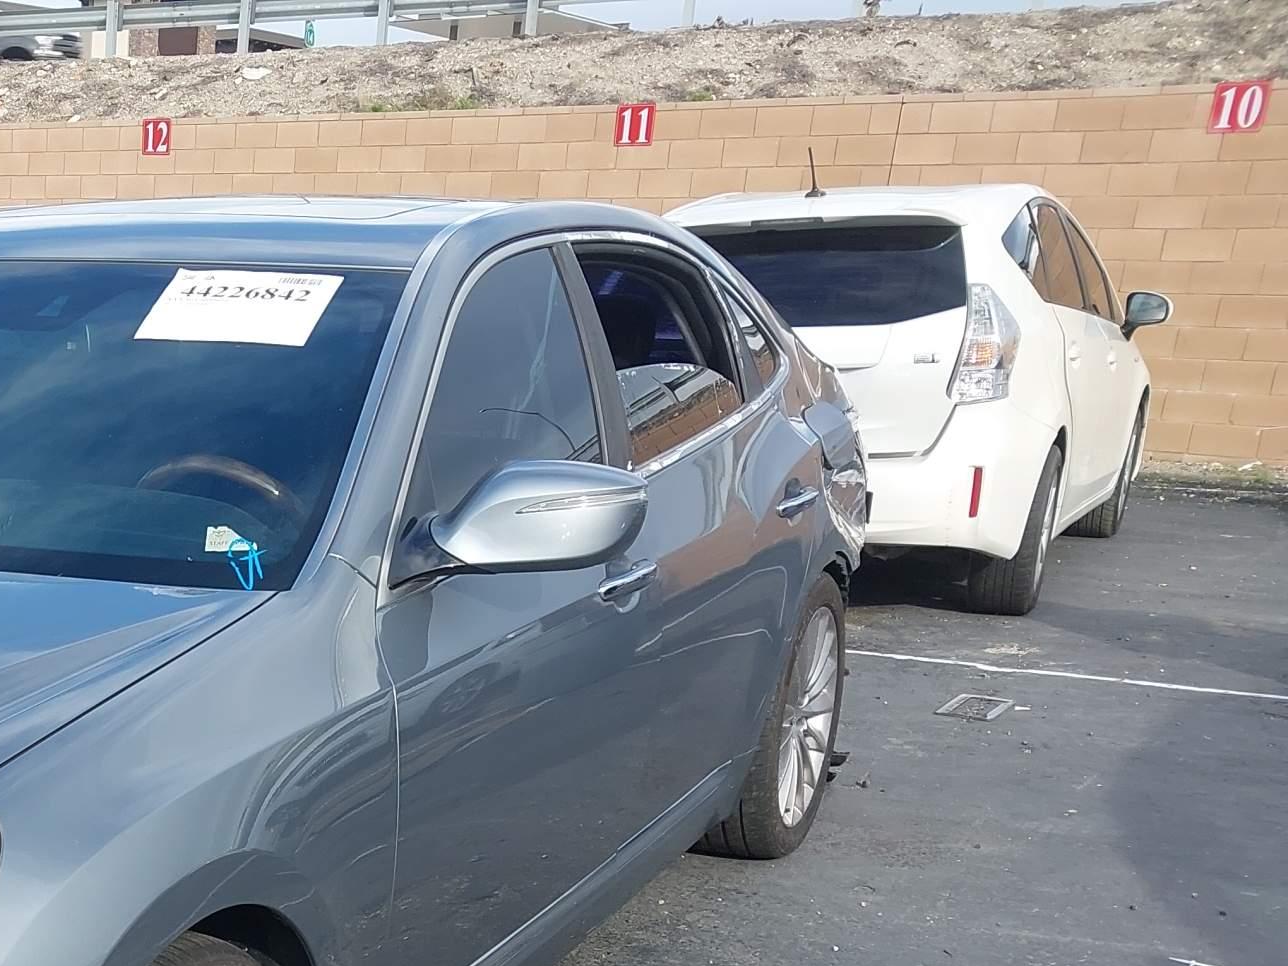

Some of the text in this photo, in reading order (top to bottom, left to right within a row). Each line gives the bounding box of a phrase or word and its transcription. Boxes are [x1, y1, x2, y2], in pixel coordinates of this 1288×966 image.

[1213, 85, 1263, 129] 10
[145, 121, 168, 153] 12
[618, 107, 649, 144] 11
[180, 285, 311, 302] 44226842
